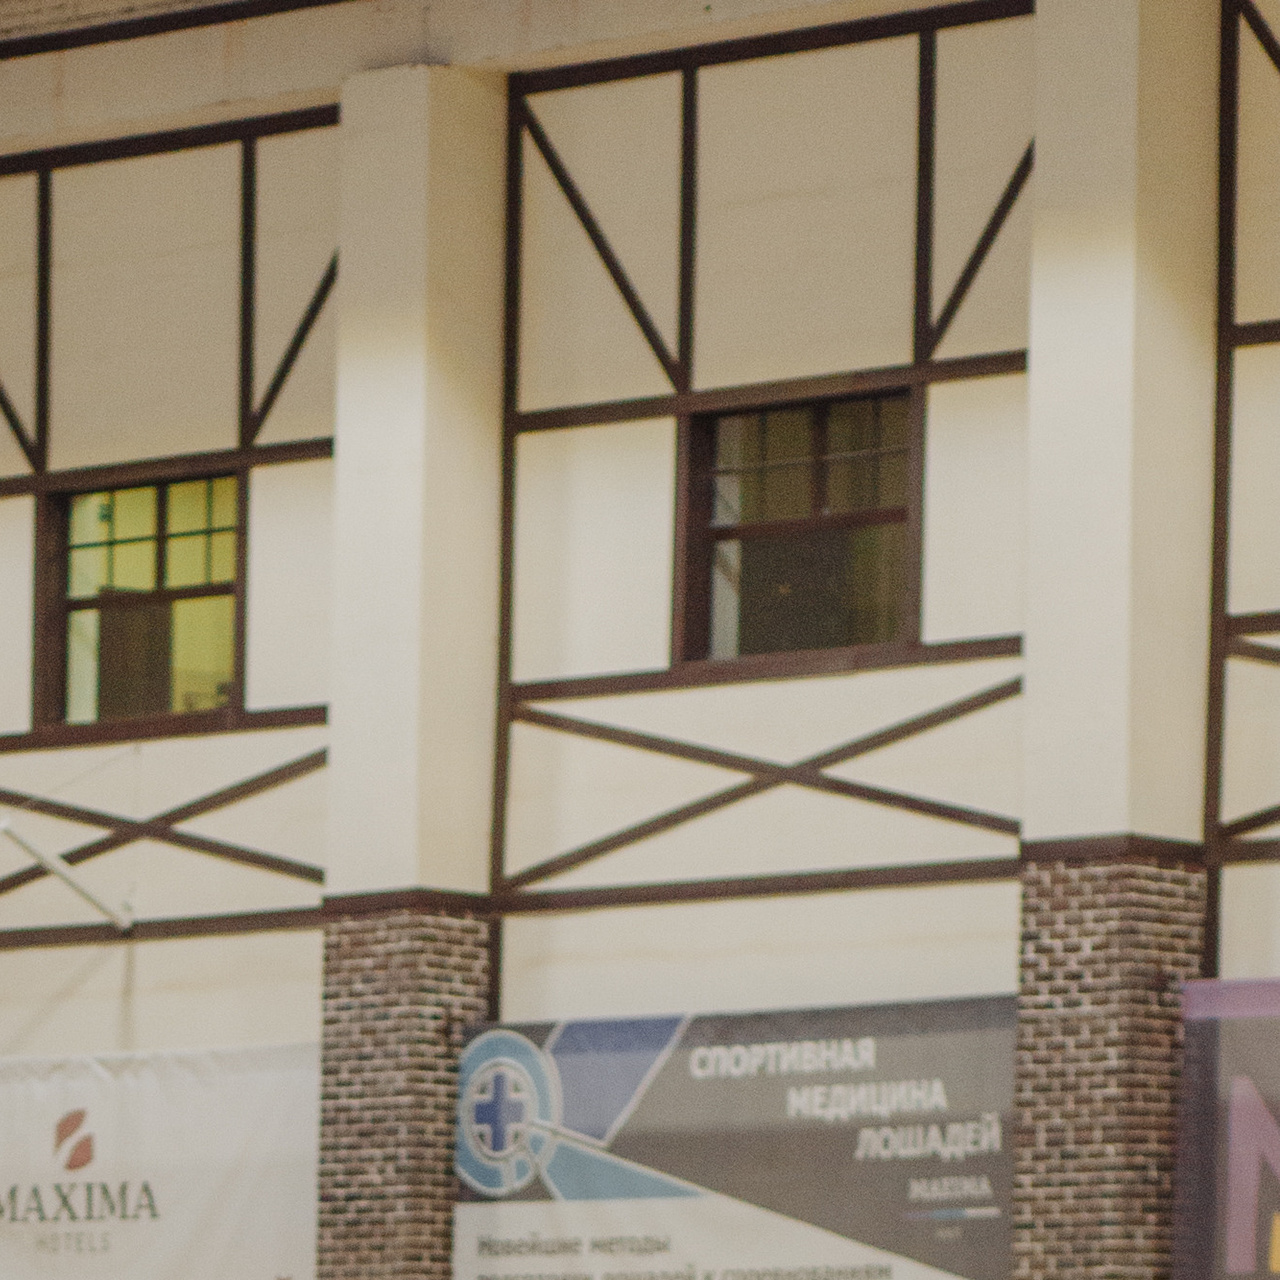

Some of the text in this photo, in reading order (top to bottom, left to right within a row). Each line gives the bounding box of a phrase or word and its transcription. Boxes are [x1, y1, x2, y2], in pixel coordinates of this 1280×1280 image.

[689, 1038, 876, 1079] СПОРТИВНАЯ
[785, 1079, 948, 1122] МЕДИЦИНА
[854, 1112, 1003, 1162] ЛОШАДЕЙ
[35, 1231, 110, 1253] HOTELS
